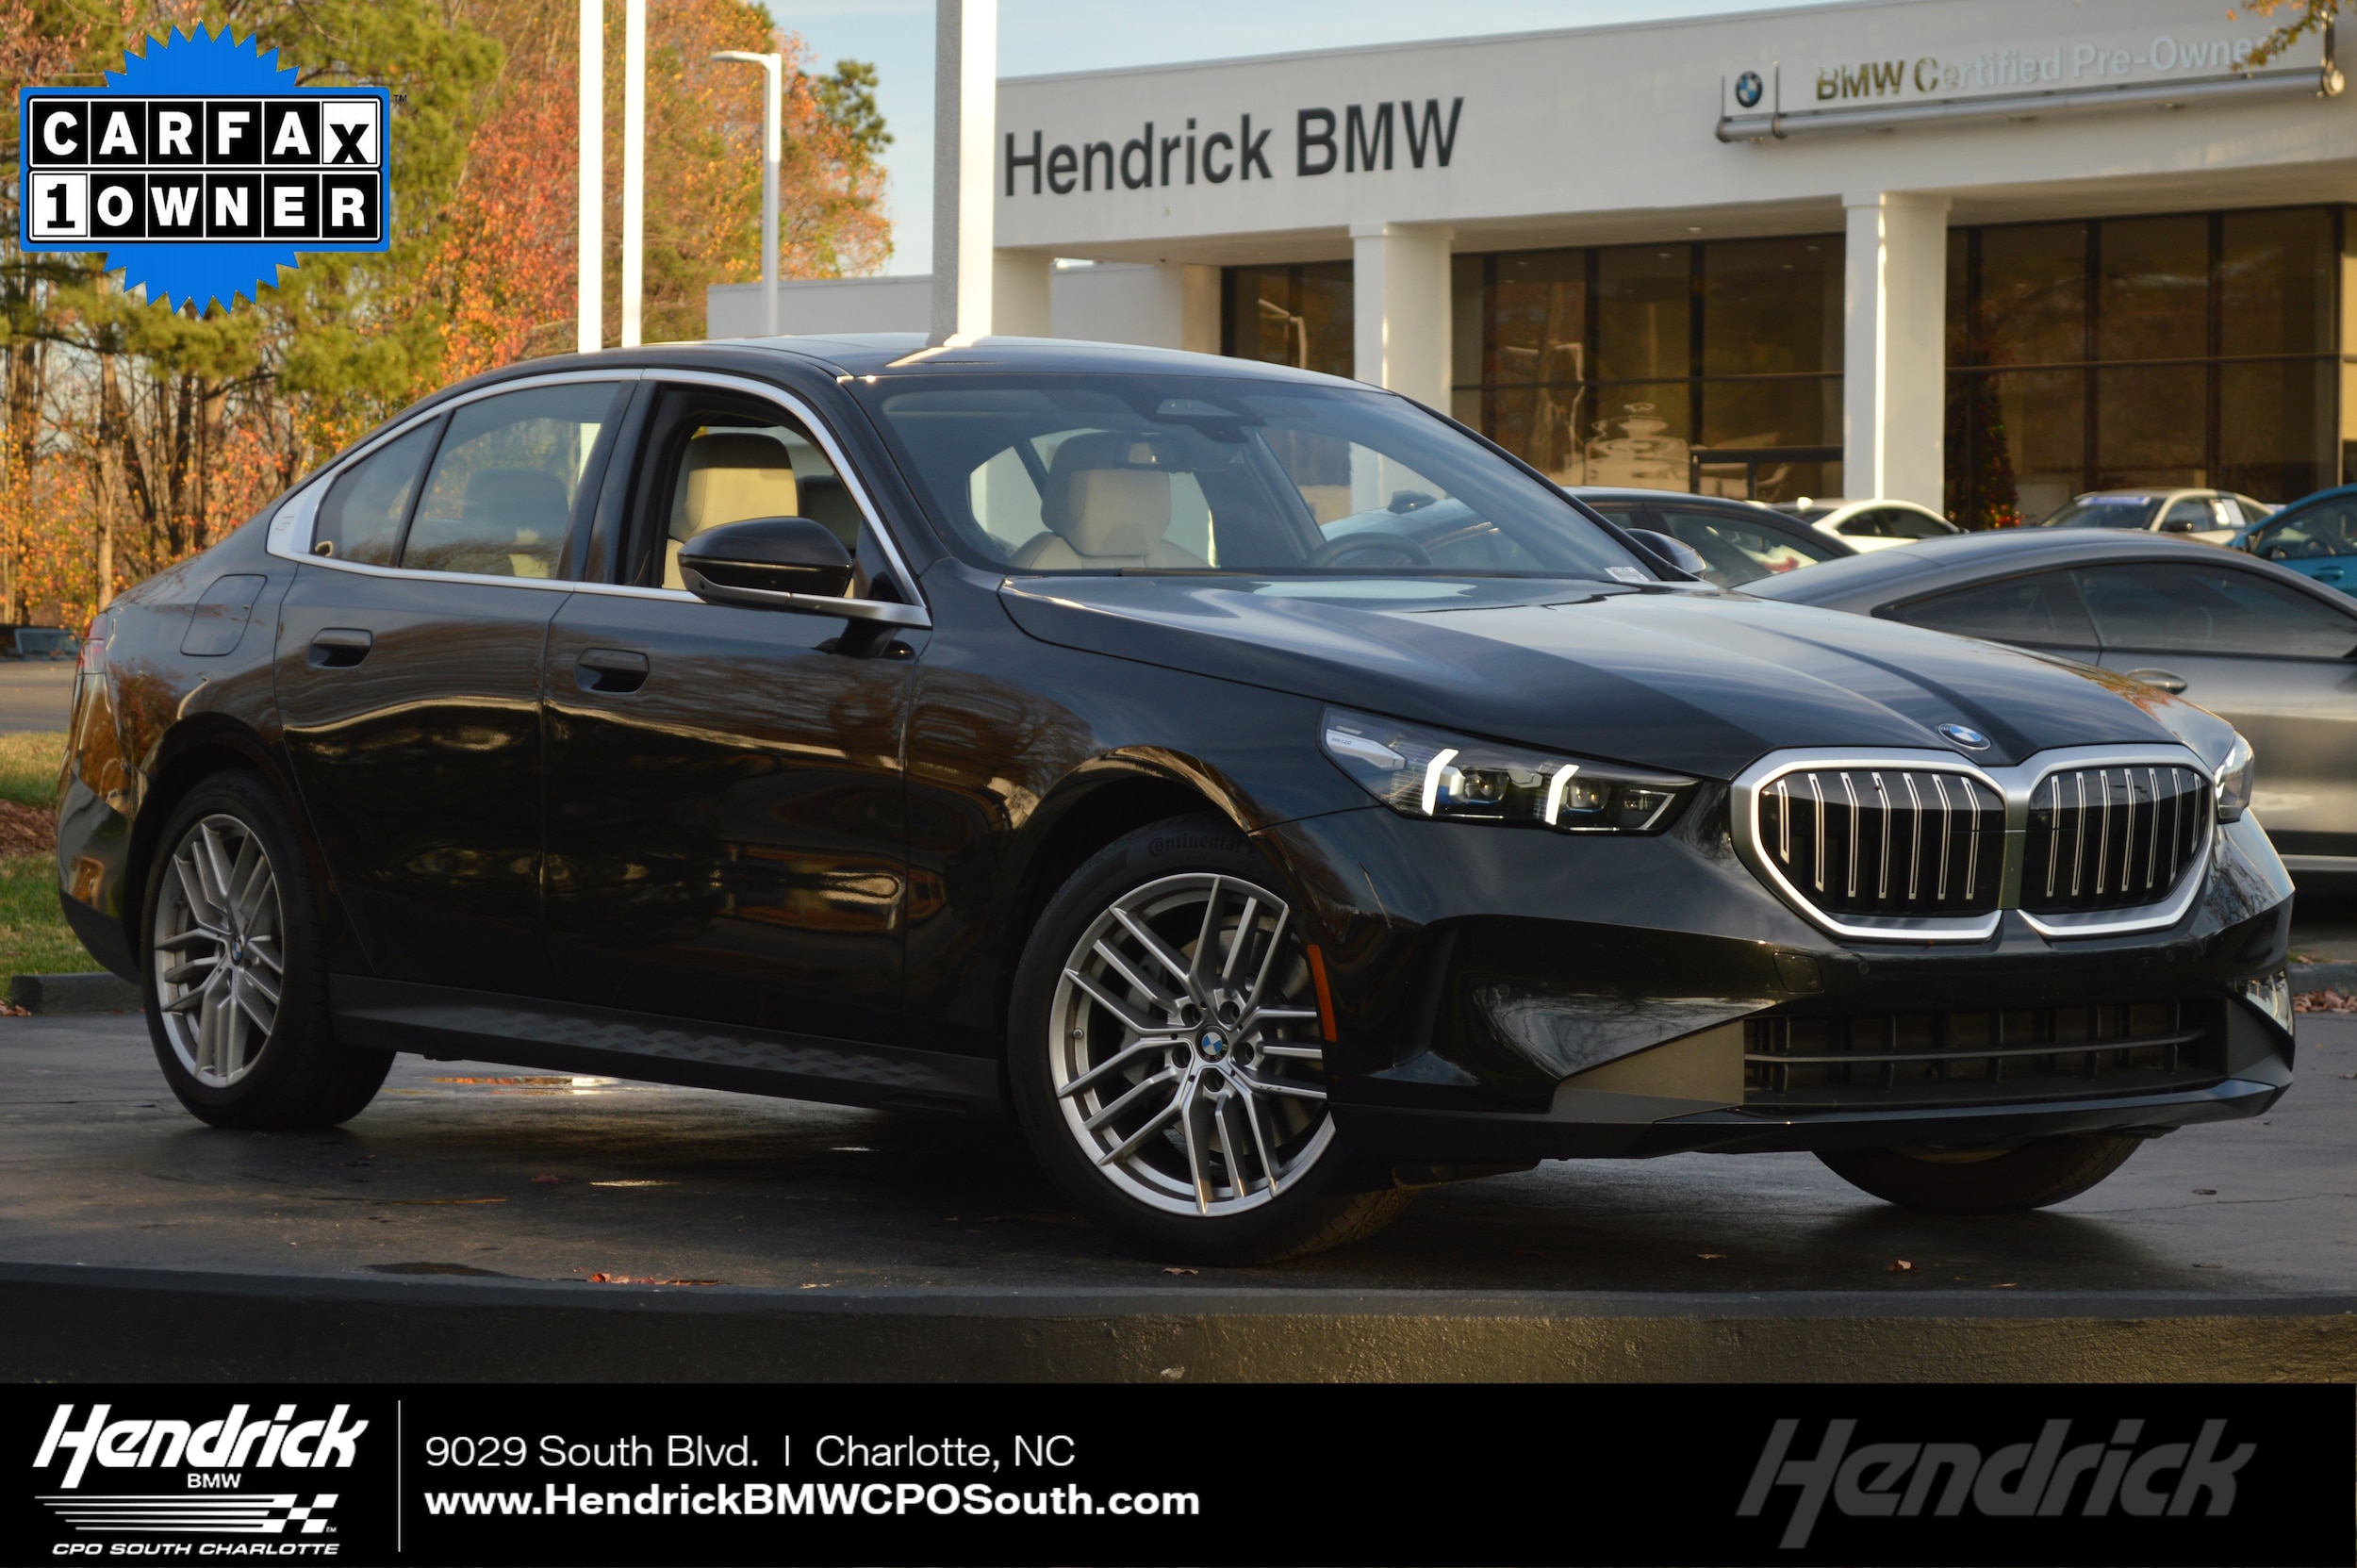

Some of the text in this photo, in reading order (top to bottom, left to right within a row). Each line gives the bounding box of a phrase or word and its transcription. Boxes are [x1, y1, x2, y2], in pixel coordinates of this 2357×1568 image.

[1816, 59, 1904, 101] BMW
[1914, 47, 2062, 92] Certified
[2073, 25, 2277, 78] Pre-Owne
[1005, 96, 1464, 197] Hendrick BMW
[1148, 834, 1243, 856] Continental
